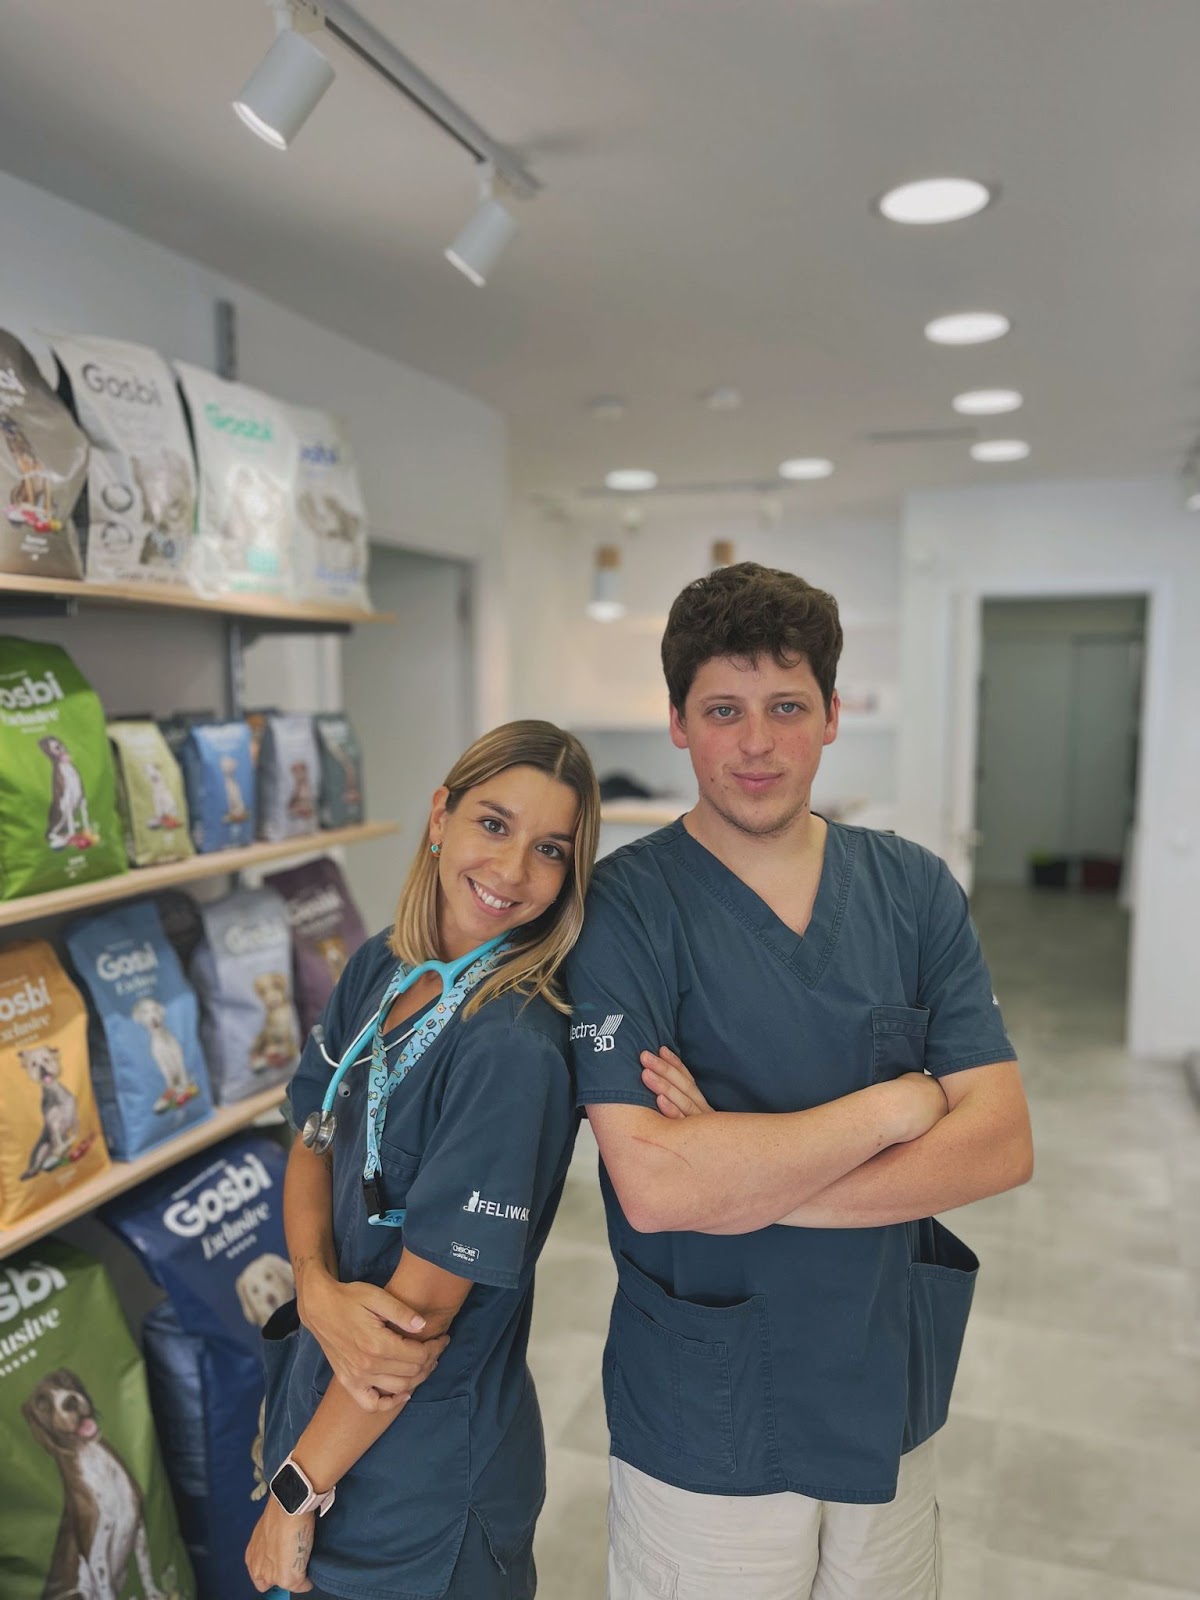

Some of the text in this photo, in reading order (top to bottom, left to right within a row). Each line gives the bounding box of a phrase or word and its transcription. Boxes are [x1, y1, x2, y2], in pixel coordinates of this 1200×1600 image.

[82, 363, 162, 407] Gosbi
[95, 941, 158, 982] Gosbi
[593, 1035, 615, 1052] 3D
[163, 1152, 272, 1237] Gosbi
